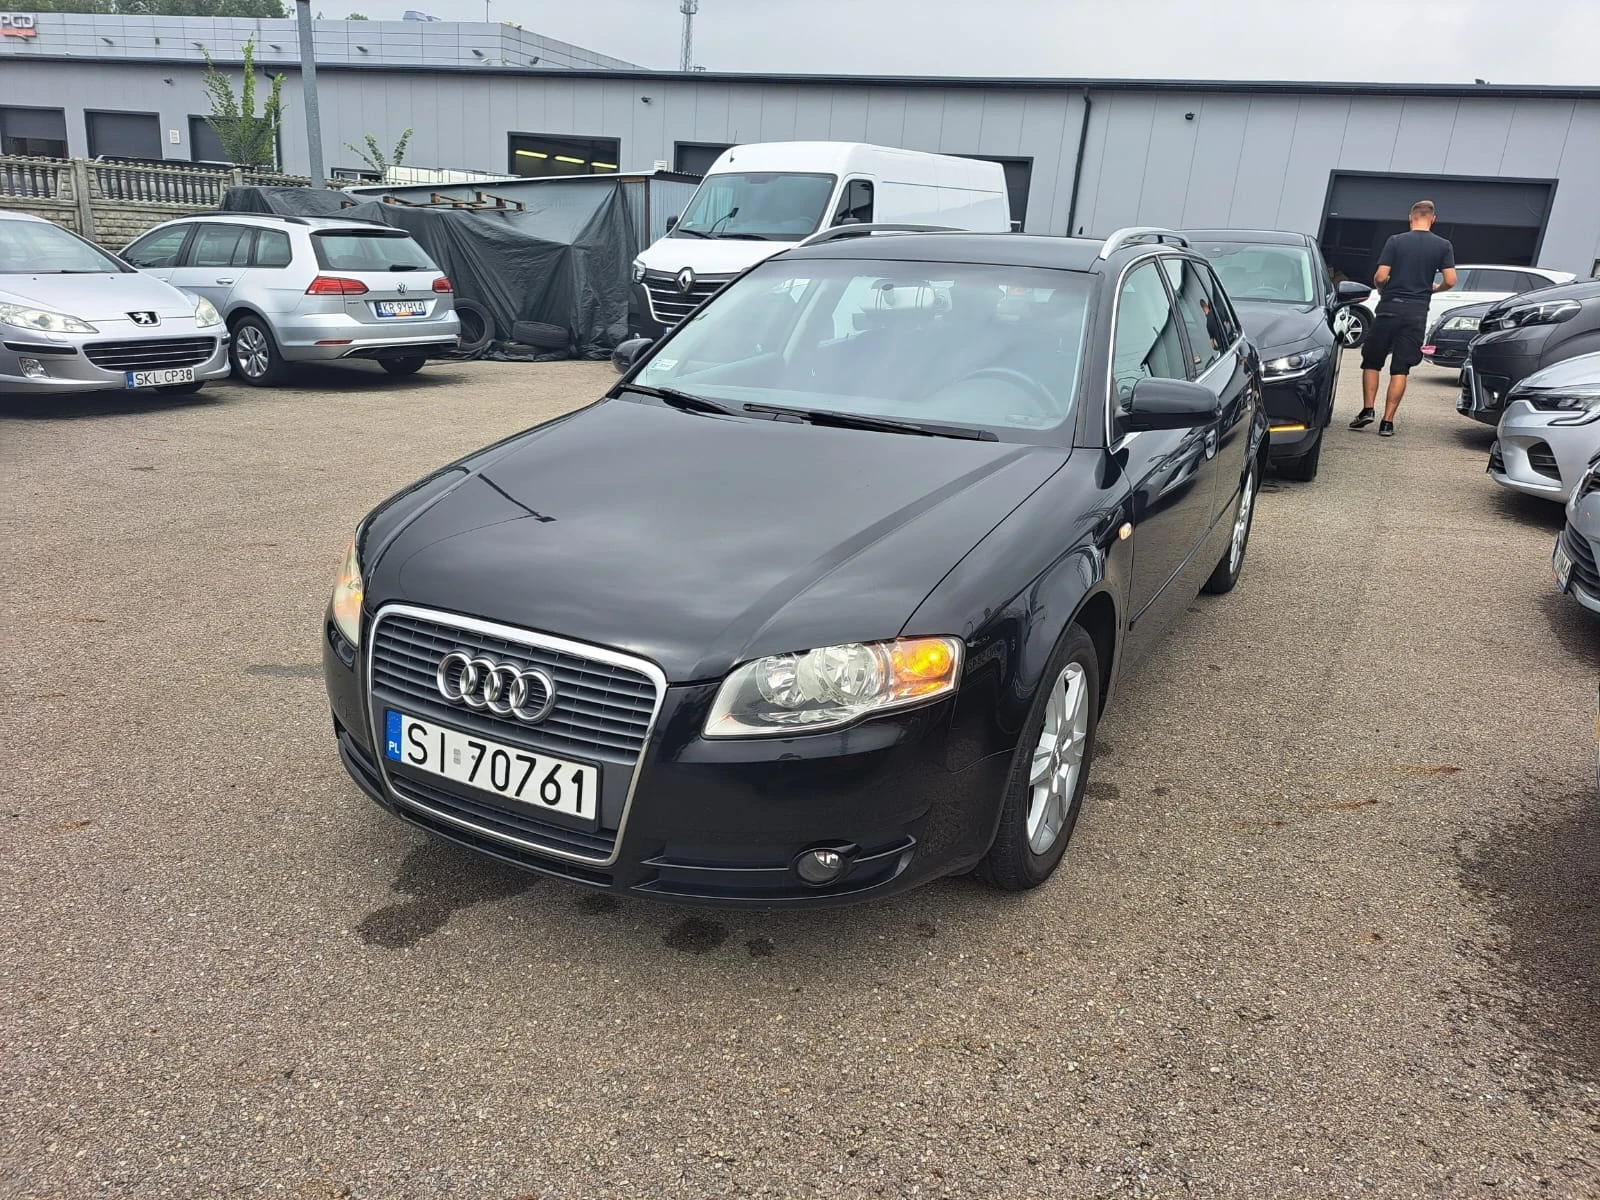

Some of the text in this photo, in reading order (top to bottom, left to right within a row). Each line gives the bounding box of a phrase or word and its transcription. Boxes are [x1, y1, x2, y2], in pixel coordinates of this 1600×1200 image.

[382, 302, 395, 313] KR
[135, 371, 160, 385] SKL
[164, 369, 192, 382] CP38
[388, 740, 400, 754] PL
[407, 722, 585, 812] SI 70761
